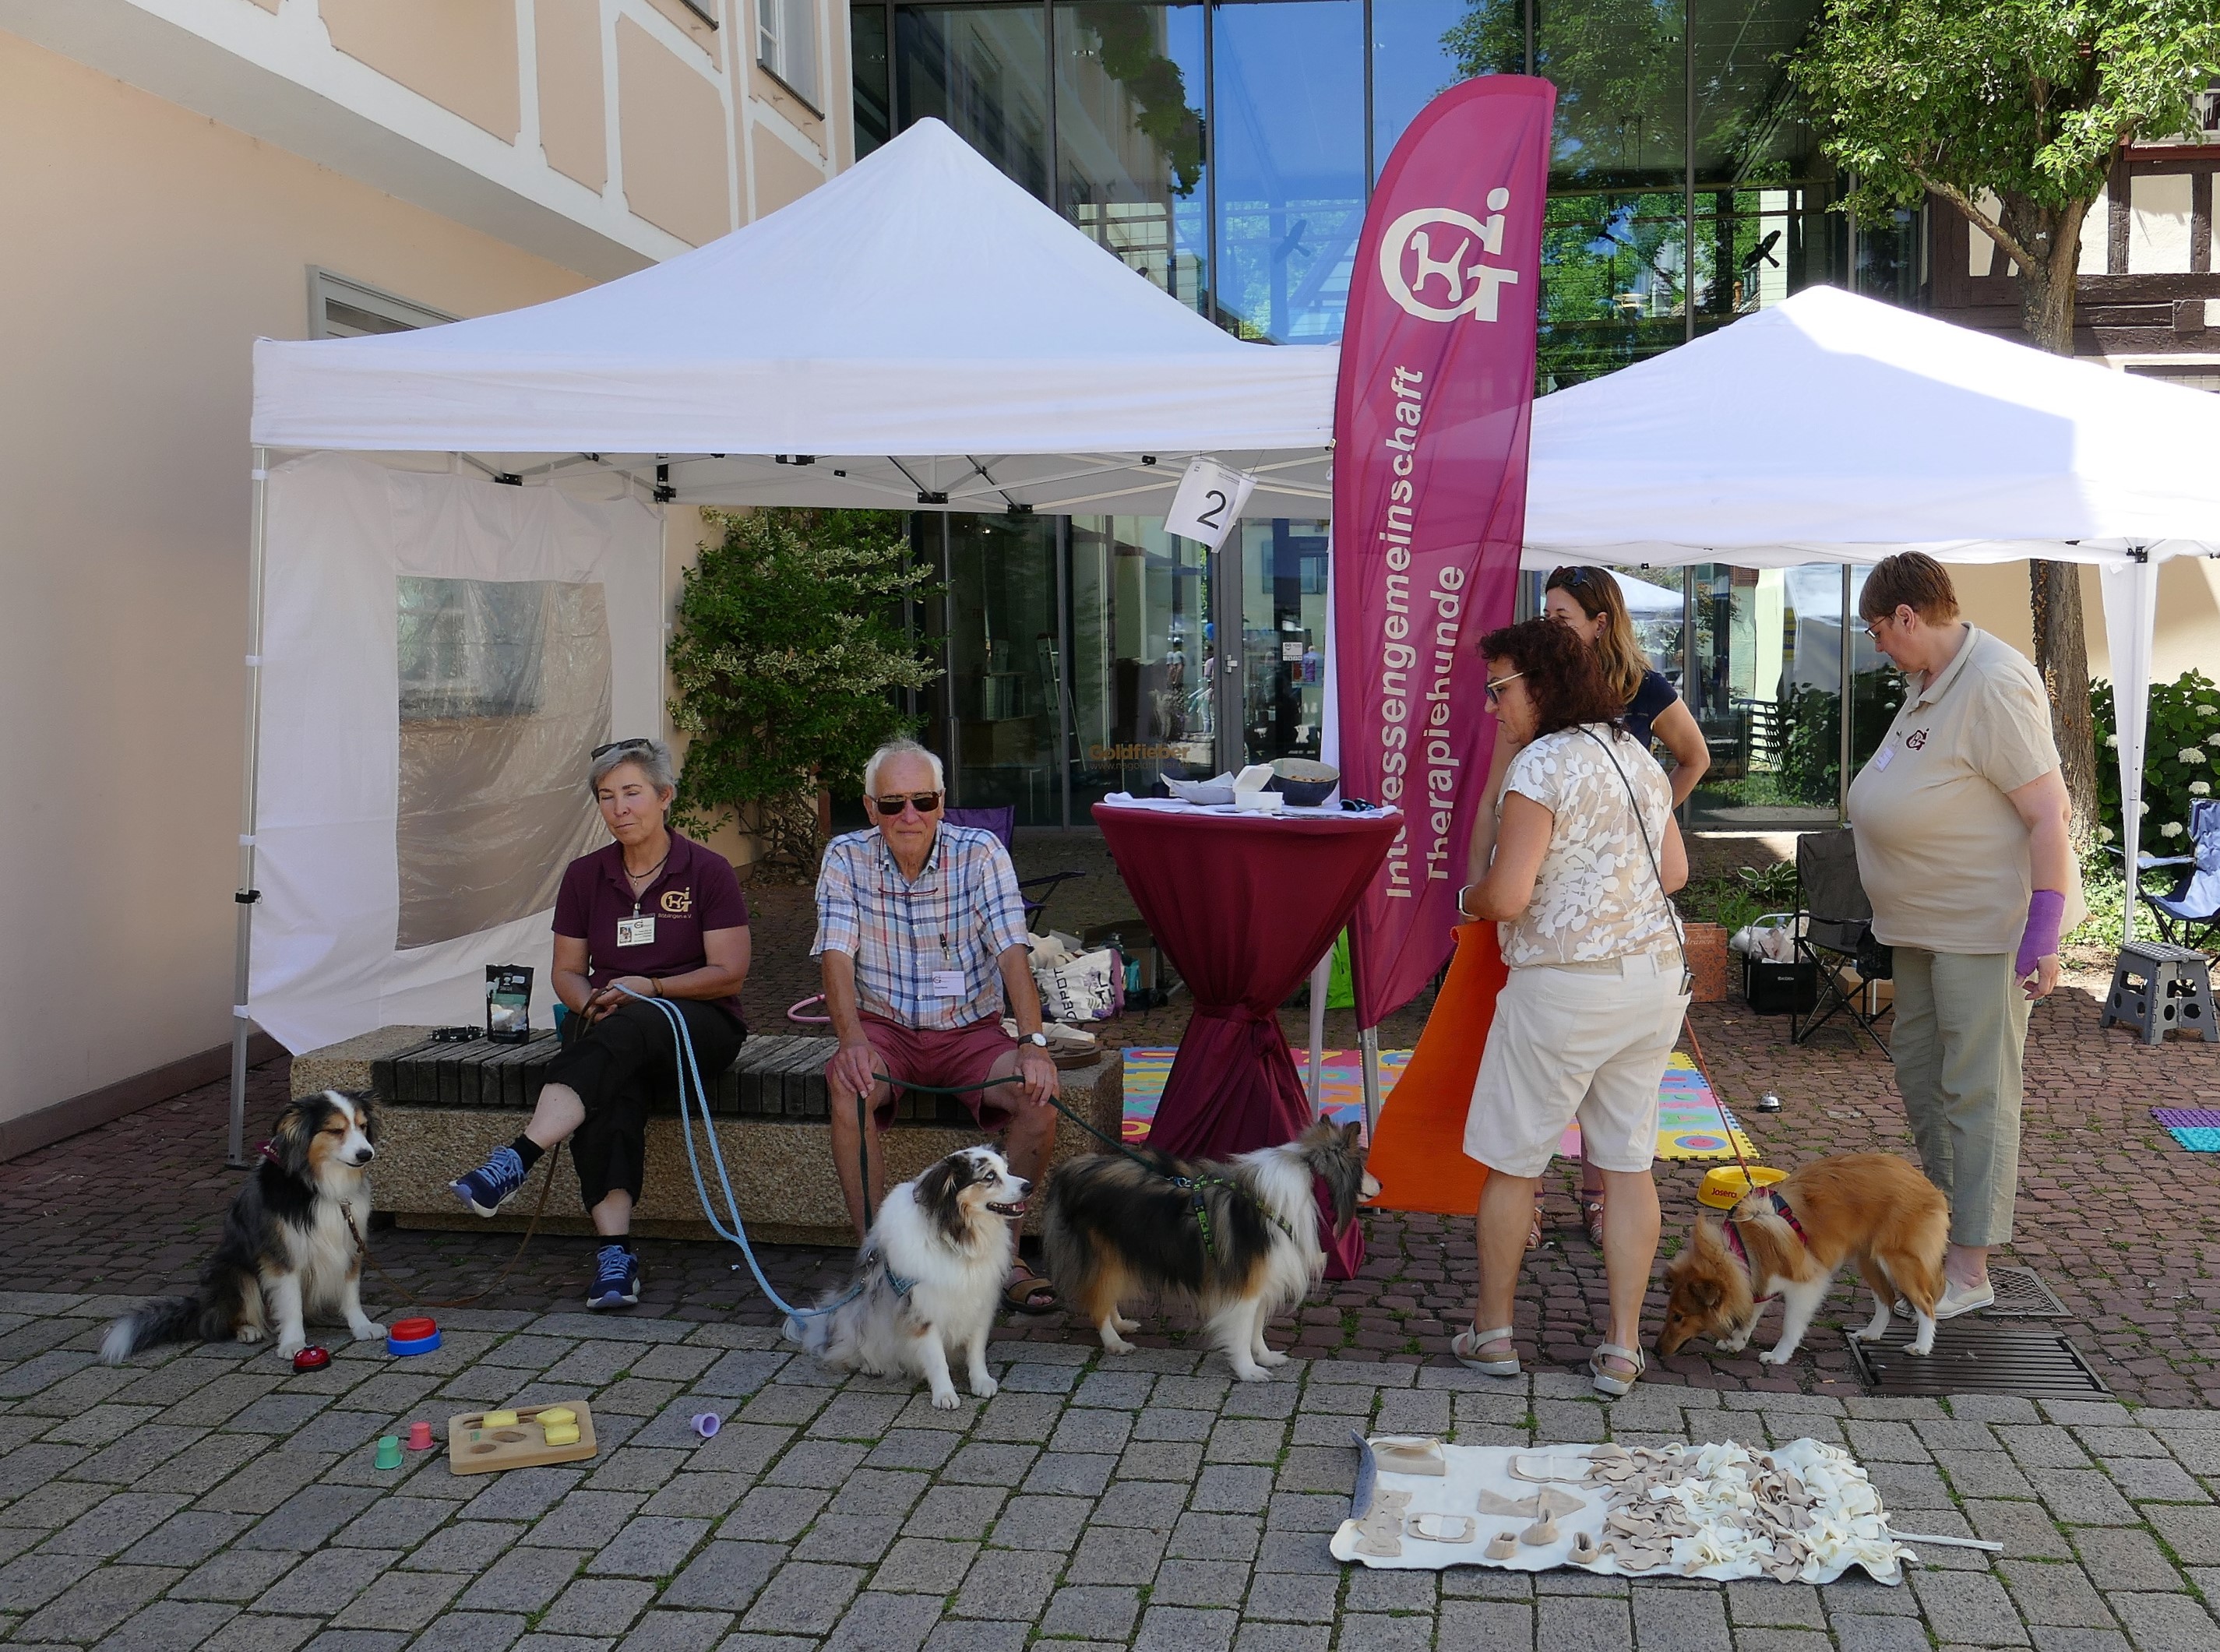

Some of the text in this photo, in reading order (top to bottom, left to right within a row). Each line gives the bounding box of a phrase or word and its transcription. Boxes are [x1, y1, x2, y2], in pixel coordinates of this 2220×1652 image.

[1196, 490, 1227, 530] 2
[1422, 565, 1465, 881] Therapiehunde
[1088, 743, 1190, 760] Goldfieber
[1053, 967, 1077, 1020] DEPOT
[1711, 1188, 1737, 1198] Josera
